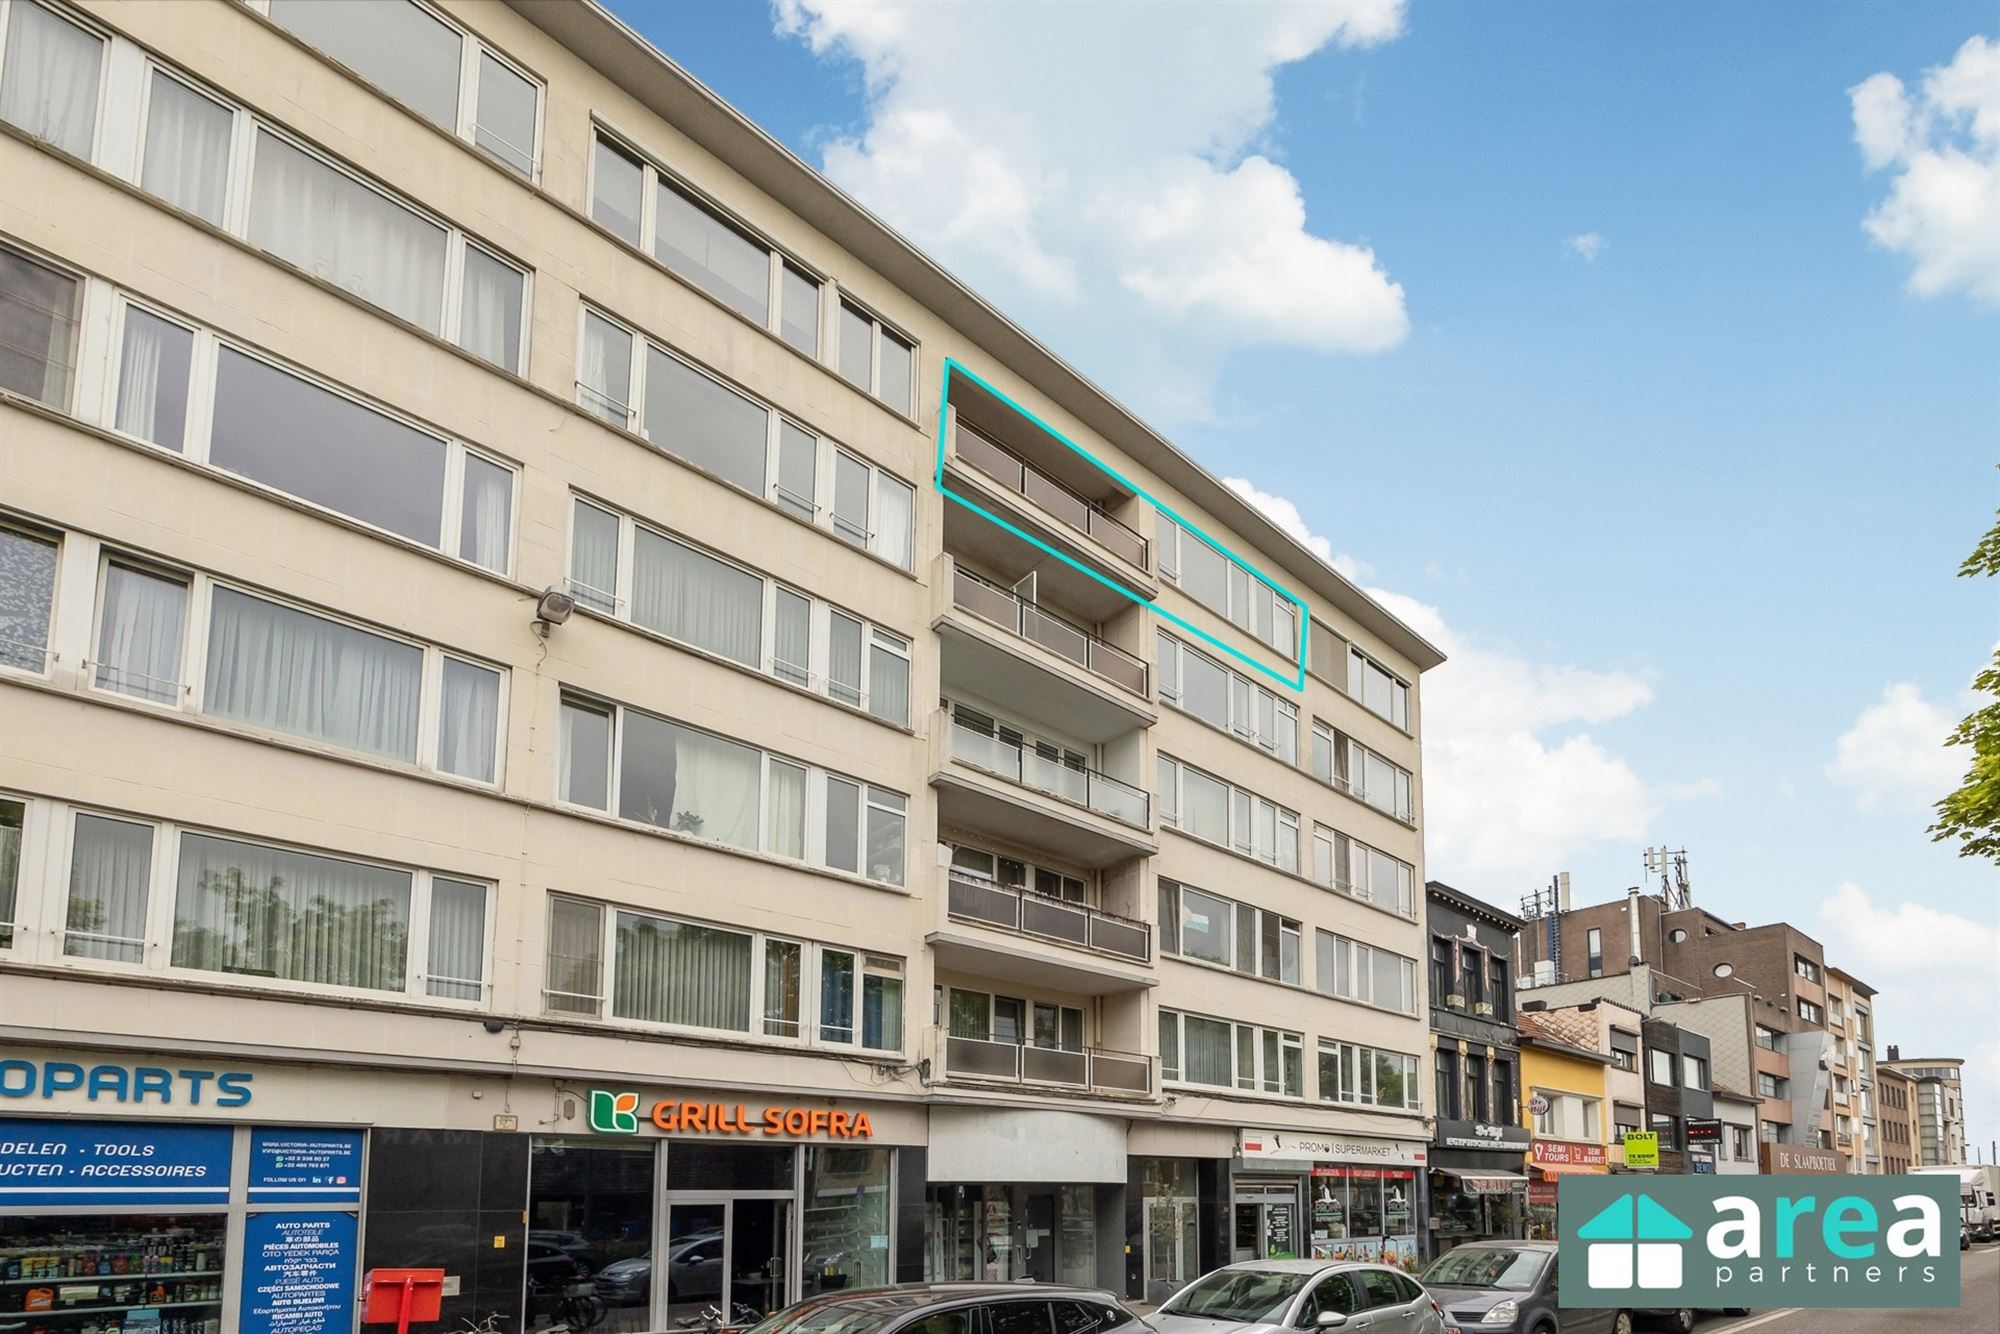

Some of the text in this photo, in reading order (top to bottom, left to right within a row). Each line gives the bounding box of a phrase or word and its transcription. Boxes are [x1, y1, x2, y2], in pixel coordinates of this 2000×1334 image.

[0, 1059, 253, 1107] OPARTS
[651, 1101, 873, 1137] GRILL SOFRA
[94, 1144, 155, 1156] TOOLS
[1336, 1143, 1391, 1156] SUPERMARKET
[1547, 1144, 1566, 1152] SEMI
[1587, 1147, 1601, 1155] SEMI
[1544, 1153, 1569, 1162] TOURS
[1583, 1155, 1605, 1164] MARKET
[1780, 1152, 1837, 1171] DE SLAAPBOETIEK
[81, 1164, 207, 1177] ACCESSOIRES
[264, 1263, 336, 1271] АВТОЗАПЧАСТИ
[285, 1283, 340, 1291] SAMOCHODOWE
[271, 1290, 326, 1299] AUTOPARTES
[270, 1325, 322, 1334] AUTOPEÇAS
